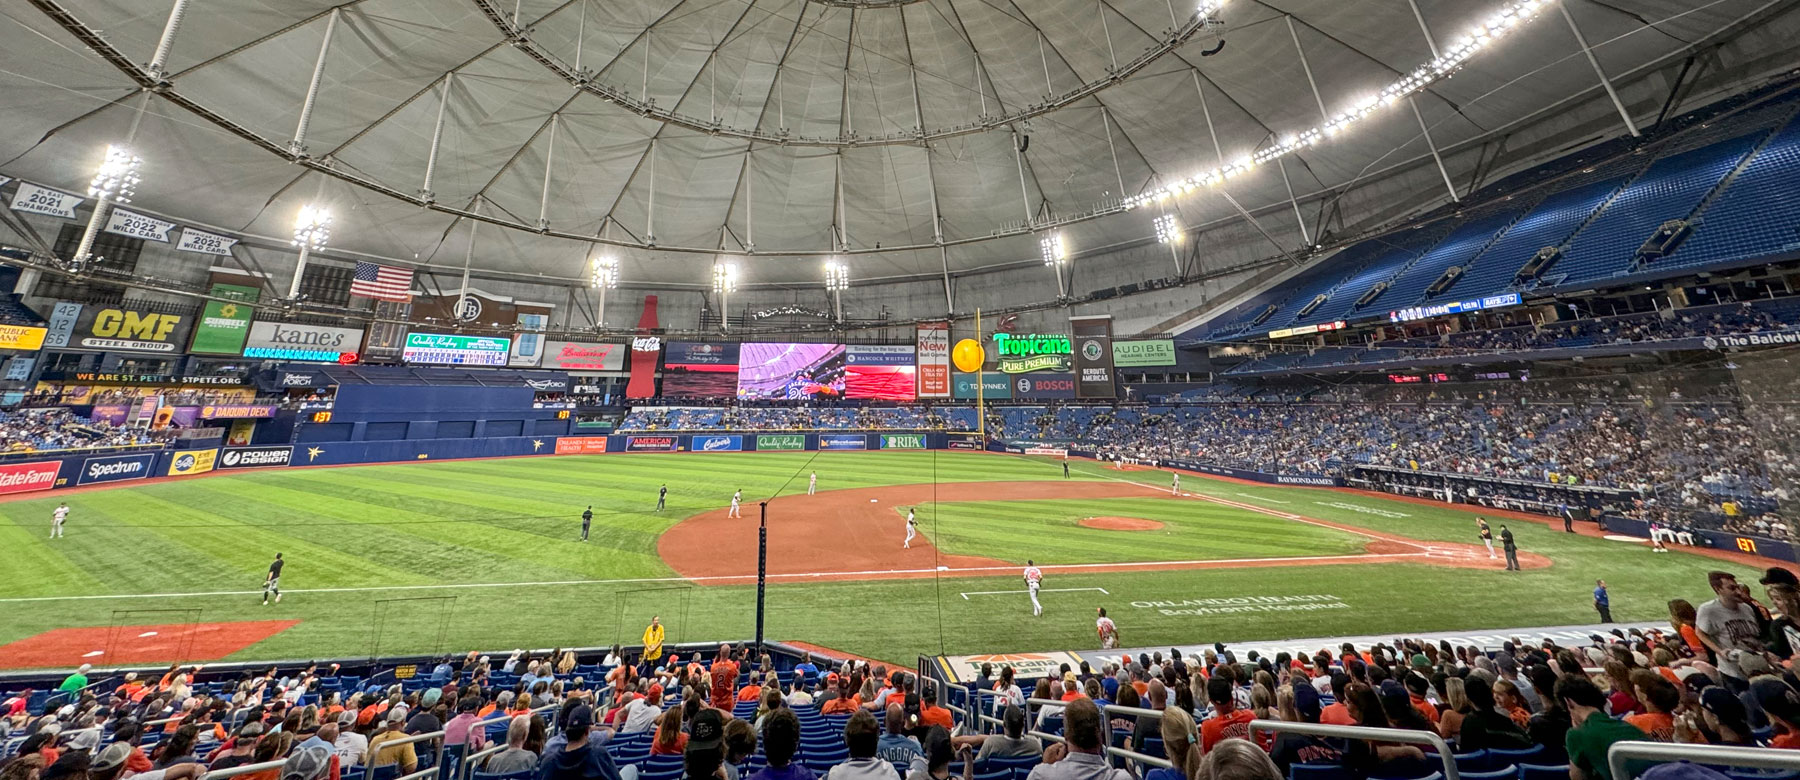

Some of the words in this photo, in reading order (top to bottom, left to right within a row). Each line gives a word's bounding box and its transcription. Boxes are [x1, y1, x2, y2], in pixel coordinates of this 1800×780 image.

[29, 194, 62, 207] 2021
[17, 201, 70, 216] CHAMPIONS
[114, 211, 146, 222] AMERICAN
[124, 218, 157, 232] 2022
[113, 223, 136, 234] WILD
[138, 229, 162, 240] CARD
[183, 242, 204, 250] WILD
[205, 246, 227, 254] CARD
[193, 236, 222, 248] 2023
[58, 305, 76, 317] 42
[54, 319, 69, 331] 12
[91, 308, 181, 341] GMF
[46, 333, 65, 344] 66
[89, 338, 128, 348] STEEL
[131, 341, 170, 351] GROUP
[632, 336, 661, 352] Coca-Cola
[993, 332, 1071, 357] Tropicana
[1720, 337, 1748, 346] The
[919, 341, 947, 351] New
[1114, 344, 1174, 353] AUDIBEL
[1002, 361, 1024, 371] PURE
[1025, 357, 1062, 369] PREMIUM
[76, 373, 95, 381] WE
[97, 373, 119, 381] ARE
[121, 374, 138, 382] ST.
[182, 376, 242, 385] STPETE.ORG
[282, 378, 312, 386] PORCH
[1035, 380, 1073, 390] BOSCH
[215, 406, 250, 417] DAIQUIRI
[250, 407, 271, 417] DECK
[895, 436, 920, 448] RIPA
[242, 450, 290, 458] POWER
[240, 456, 288, 465] DESIGN
[89, 461, 140, 479] Spectrum
[1278, 476, 1311, 484] RAYMOND
[1311, 477, 1334, 485] JAMES
[1130, 595, 1250, 609] ORLANDO
[1250, 593, 1342, 605] HEALTH
[1158, 606, 1261, 616] Bayfront
[1261, 601, 1352, 612] Hospital
[716, 674, 725, 688] 2
